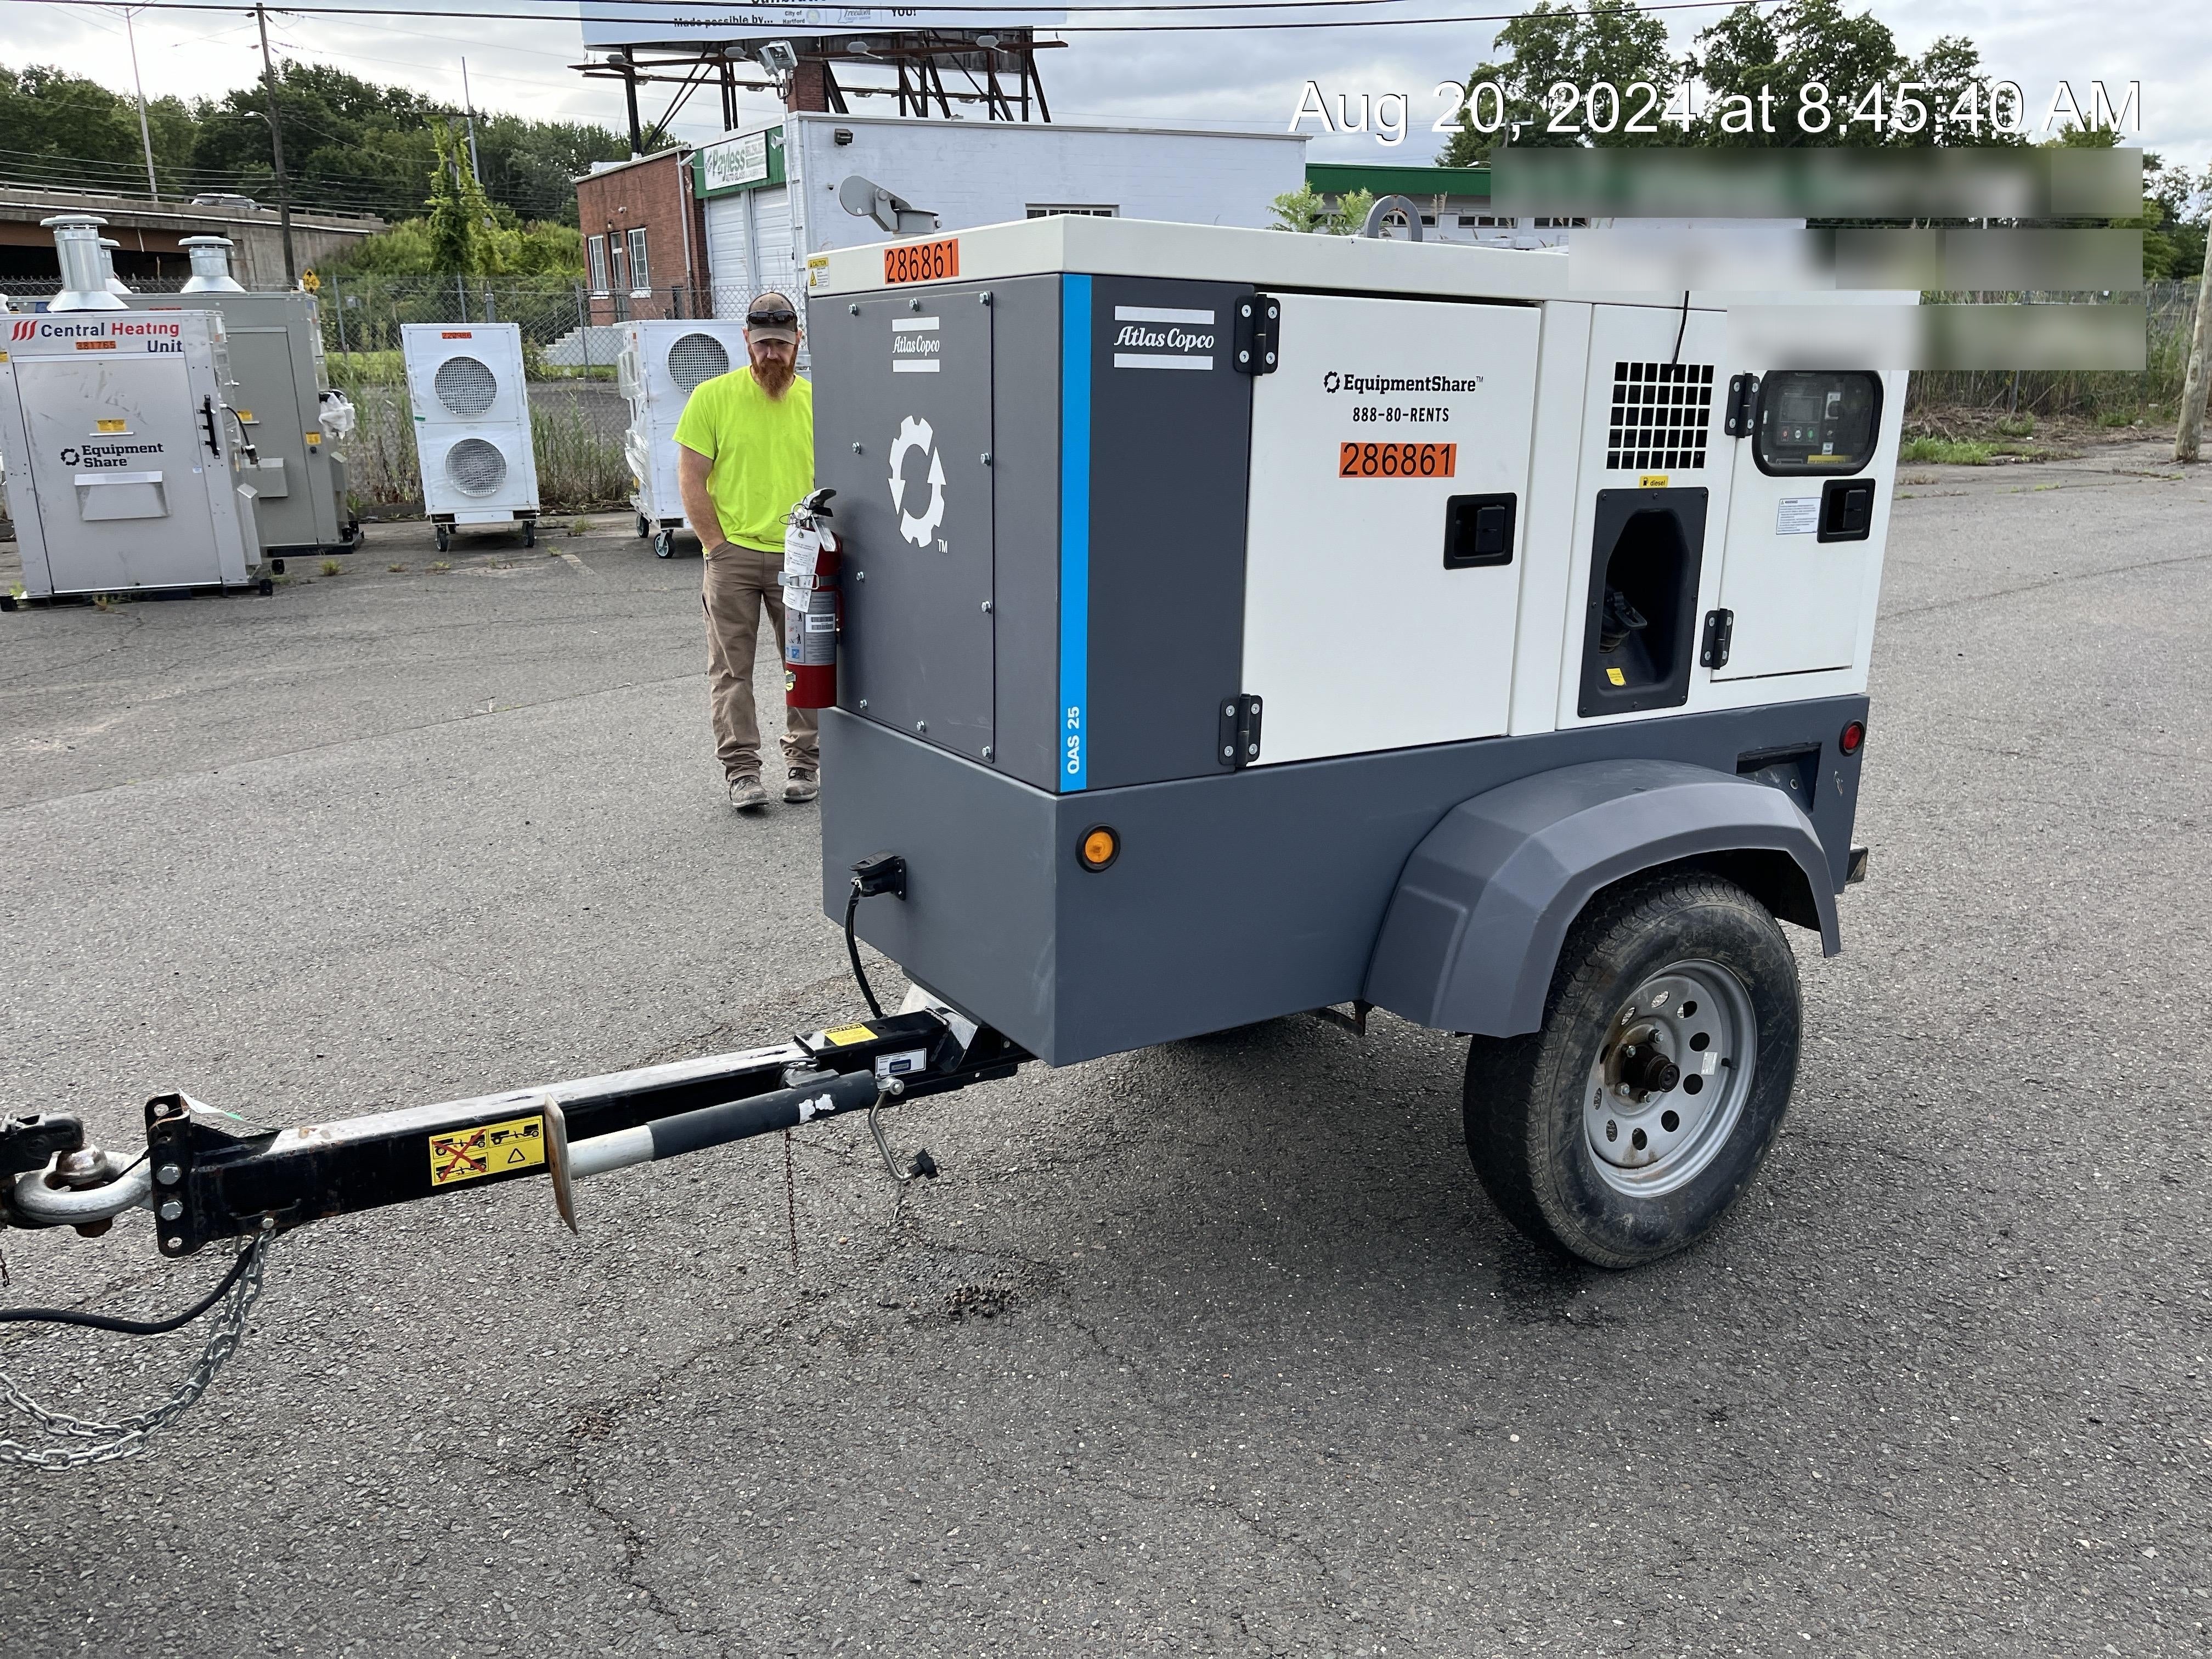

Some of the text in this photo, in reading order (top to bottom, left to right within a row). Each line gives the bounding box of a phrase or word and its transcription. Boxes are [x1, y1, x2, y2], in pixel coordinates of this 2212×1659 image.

[713, 145, 745, 182] Payless
[886, 241, 953, 283] 286861
[41, 322, 179, 337] Central Heating
[148, 340, 182, 352] Unit
[892, 335, 940, 357] Atlas Copco
[1114, 326, 1214, 352] Atlas Copco
[1344, 374, 1476, 394] EquipmentShare
[1352, 407, 1449, 422] 888-80-RENTS
[81, 443, 164, 457] Equipment
[83, 458, 127, 467] Share
[1342, 443, 1450, 476] 286861
[938, 539, 947, 553] TM
[1067, 706, 1080, 774] QAS 25
[824, 1024, 862, 1034] CAUTION
